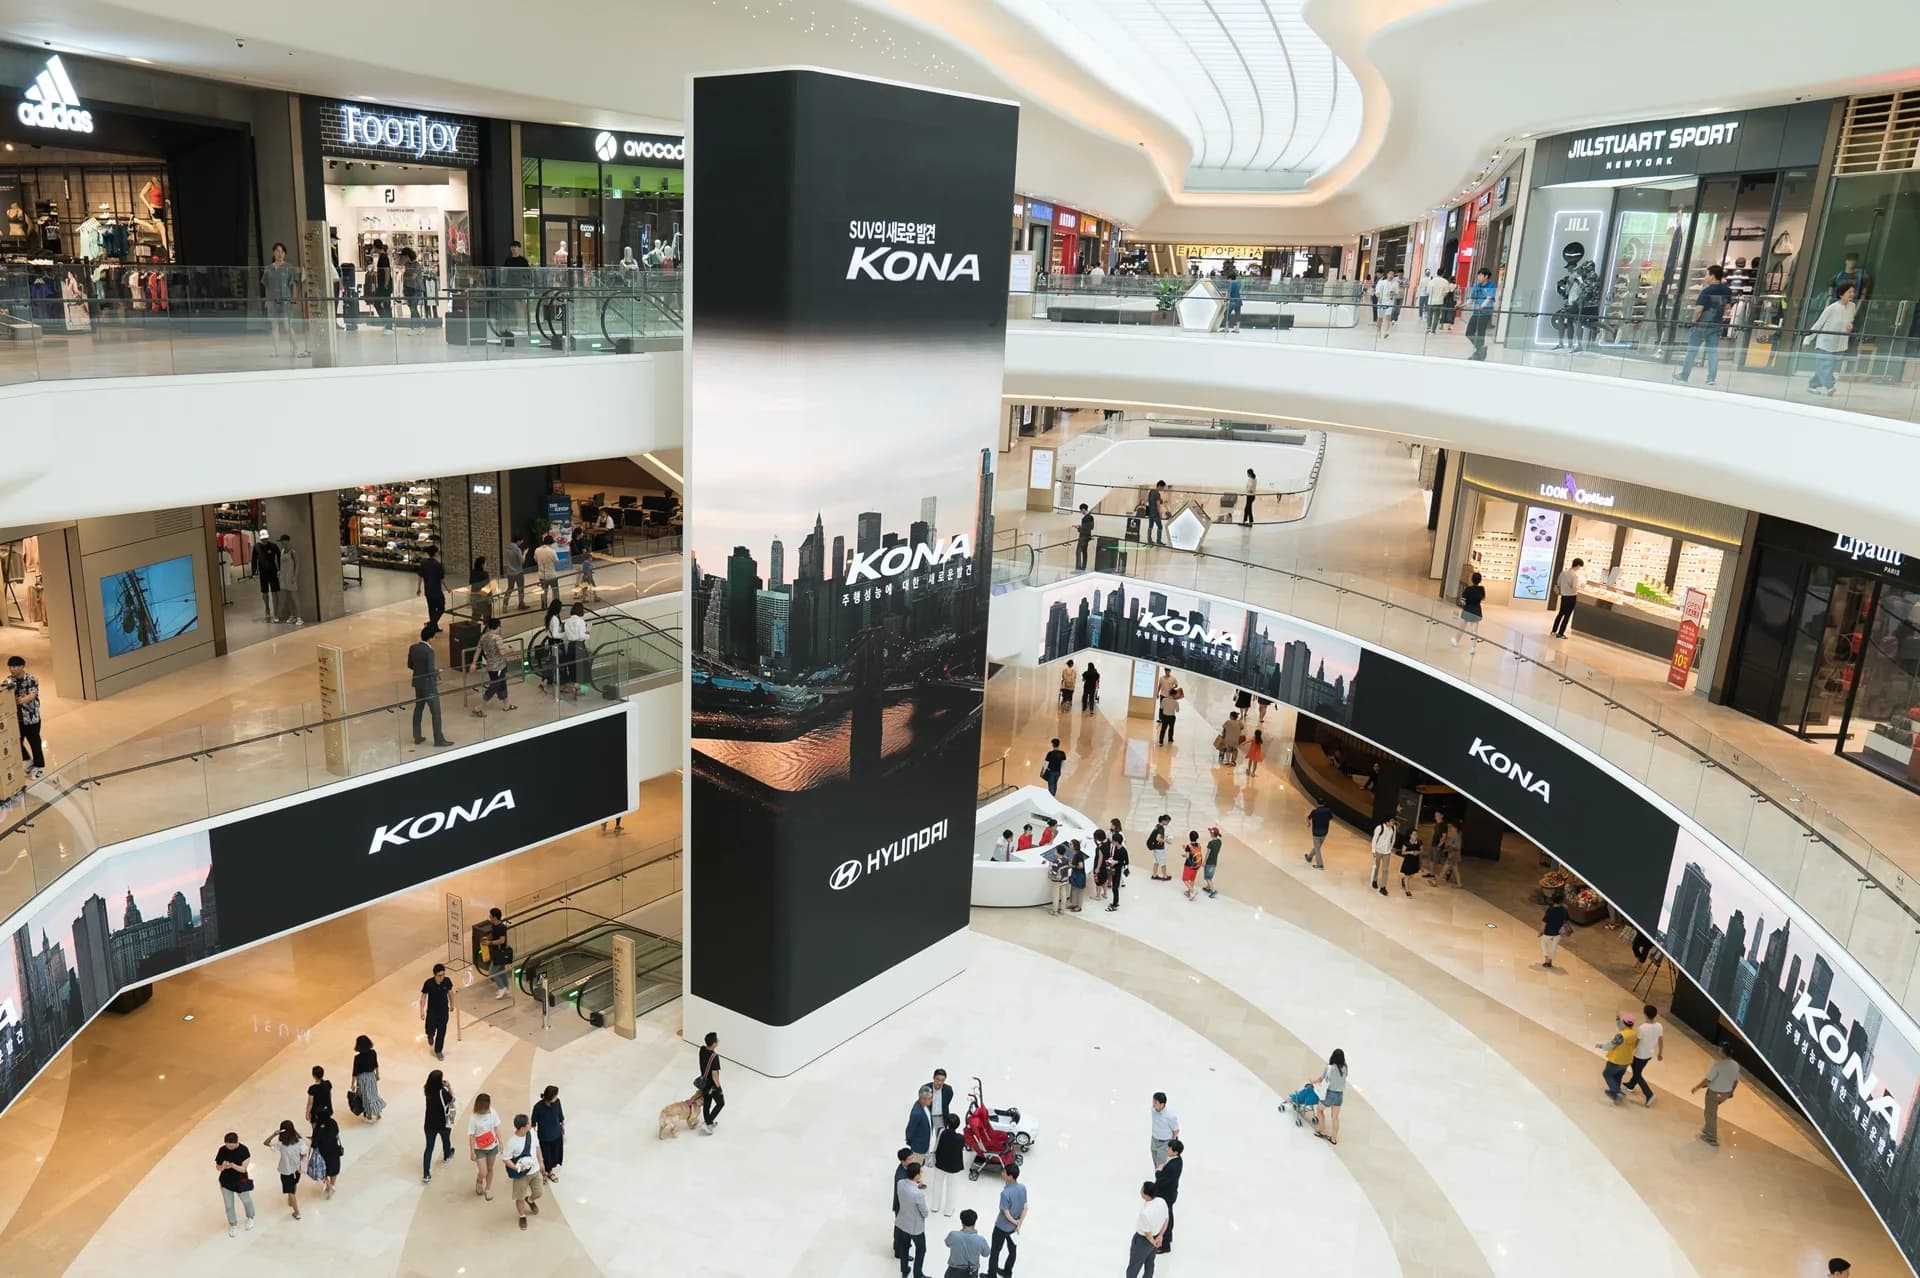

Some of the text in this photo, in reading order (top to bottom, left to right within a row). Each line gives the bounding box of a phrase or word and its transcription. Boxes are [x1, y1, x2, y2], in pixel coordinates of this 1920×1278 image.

[17, 101, 94, 133] adidas
[1568, 122, 1739, 159] JILLSTUART SPORT
[846, 246, 981, 282] KONA
[1540, 483, 1615, 507] LOOK Optical
[845, 533, 972, 586] KONA
[1883, 566, 1901, 577] PARIS
[1138, 610, 1240, 654] KONA
[1468, 736, 1551, 804] KONA
[368, 789, 516, 855] KONA
[866, 818, 949, 874] HYUNDAI
[1792, 992, 1901, 1144] KONA
